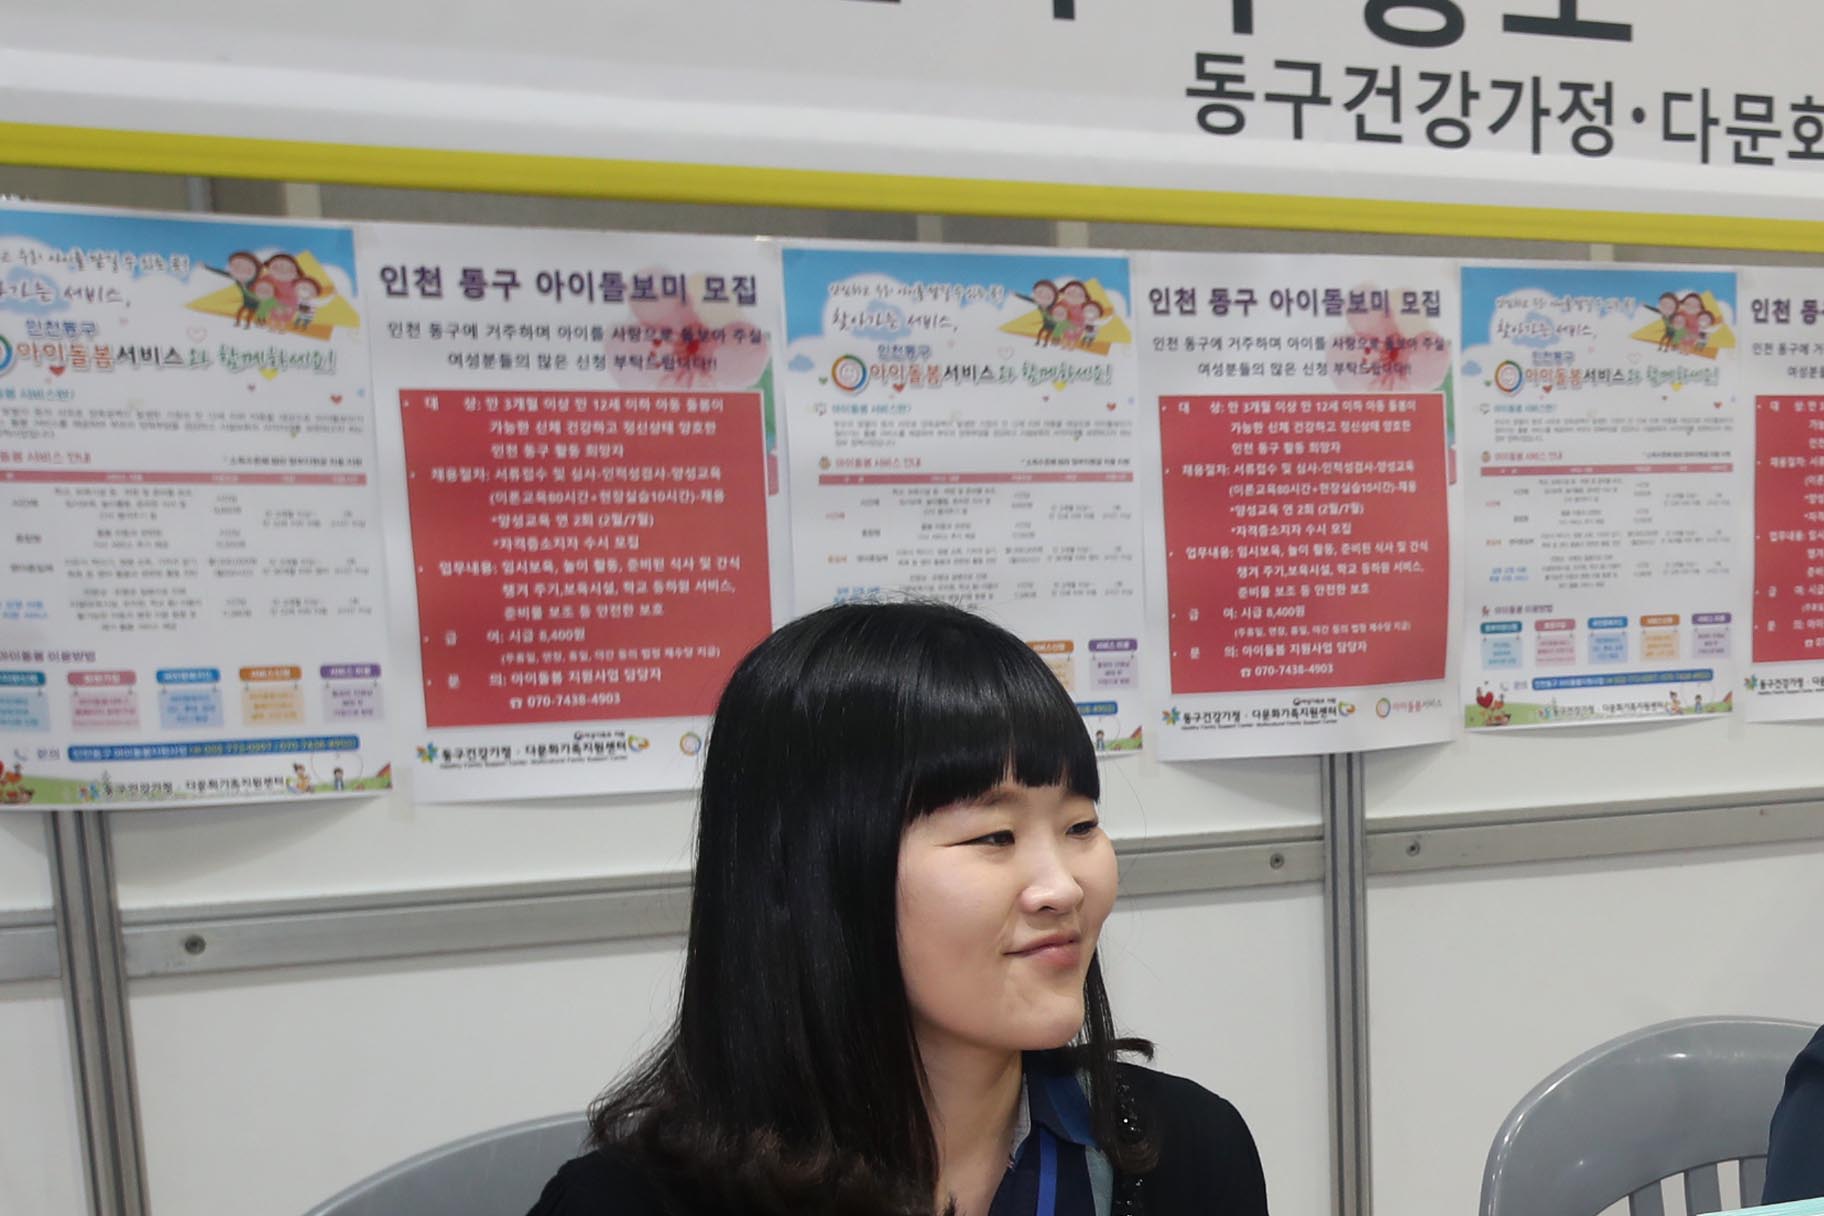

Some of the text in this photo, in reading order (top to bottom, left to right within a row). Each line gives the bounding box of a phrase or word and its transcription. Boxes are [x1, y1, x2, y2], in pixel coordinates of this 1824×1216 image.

[378, 264, 757, 307] 인천 동구 아이돌보미 모집
[1147, 286, 1441, 318] 인천 동구 아이돌보미 모집
[1750, 297, 1791, 325] 인천
[1254, 663, 1334, 678] 070-7438-4903
[528, 693, 621, 708] 070-7438-4903
